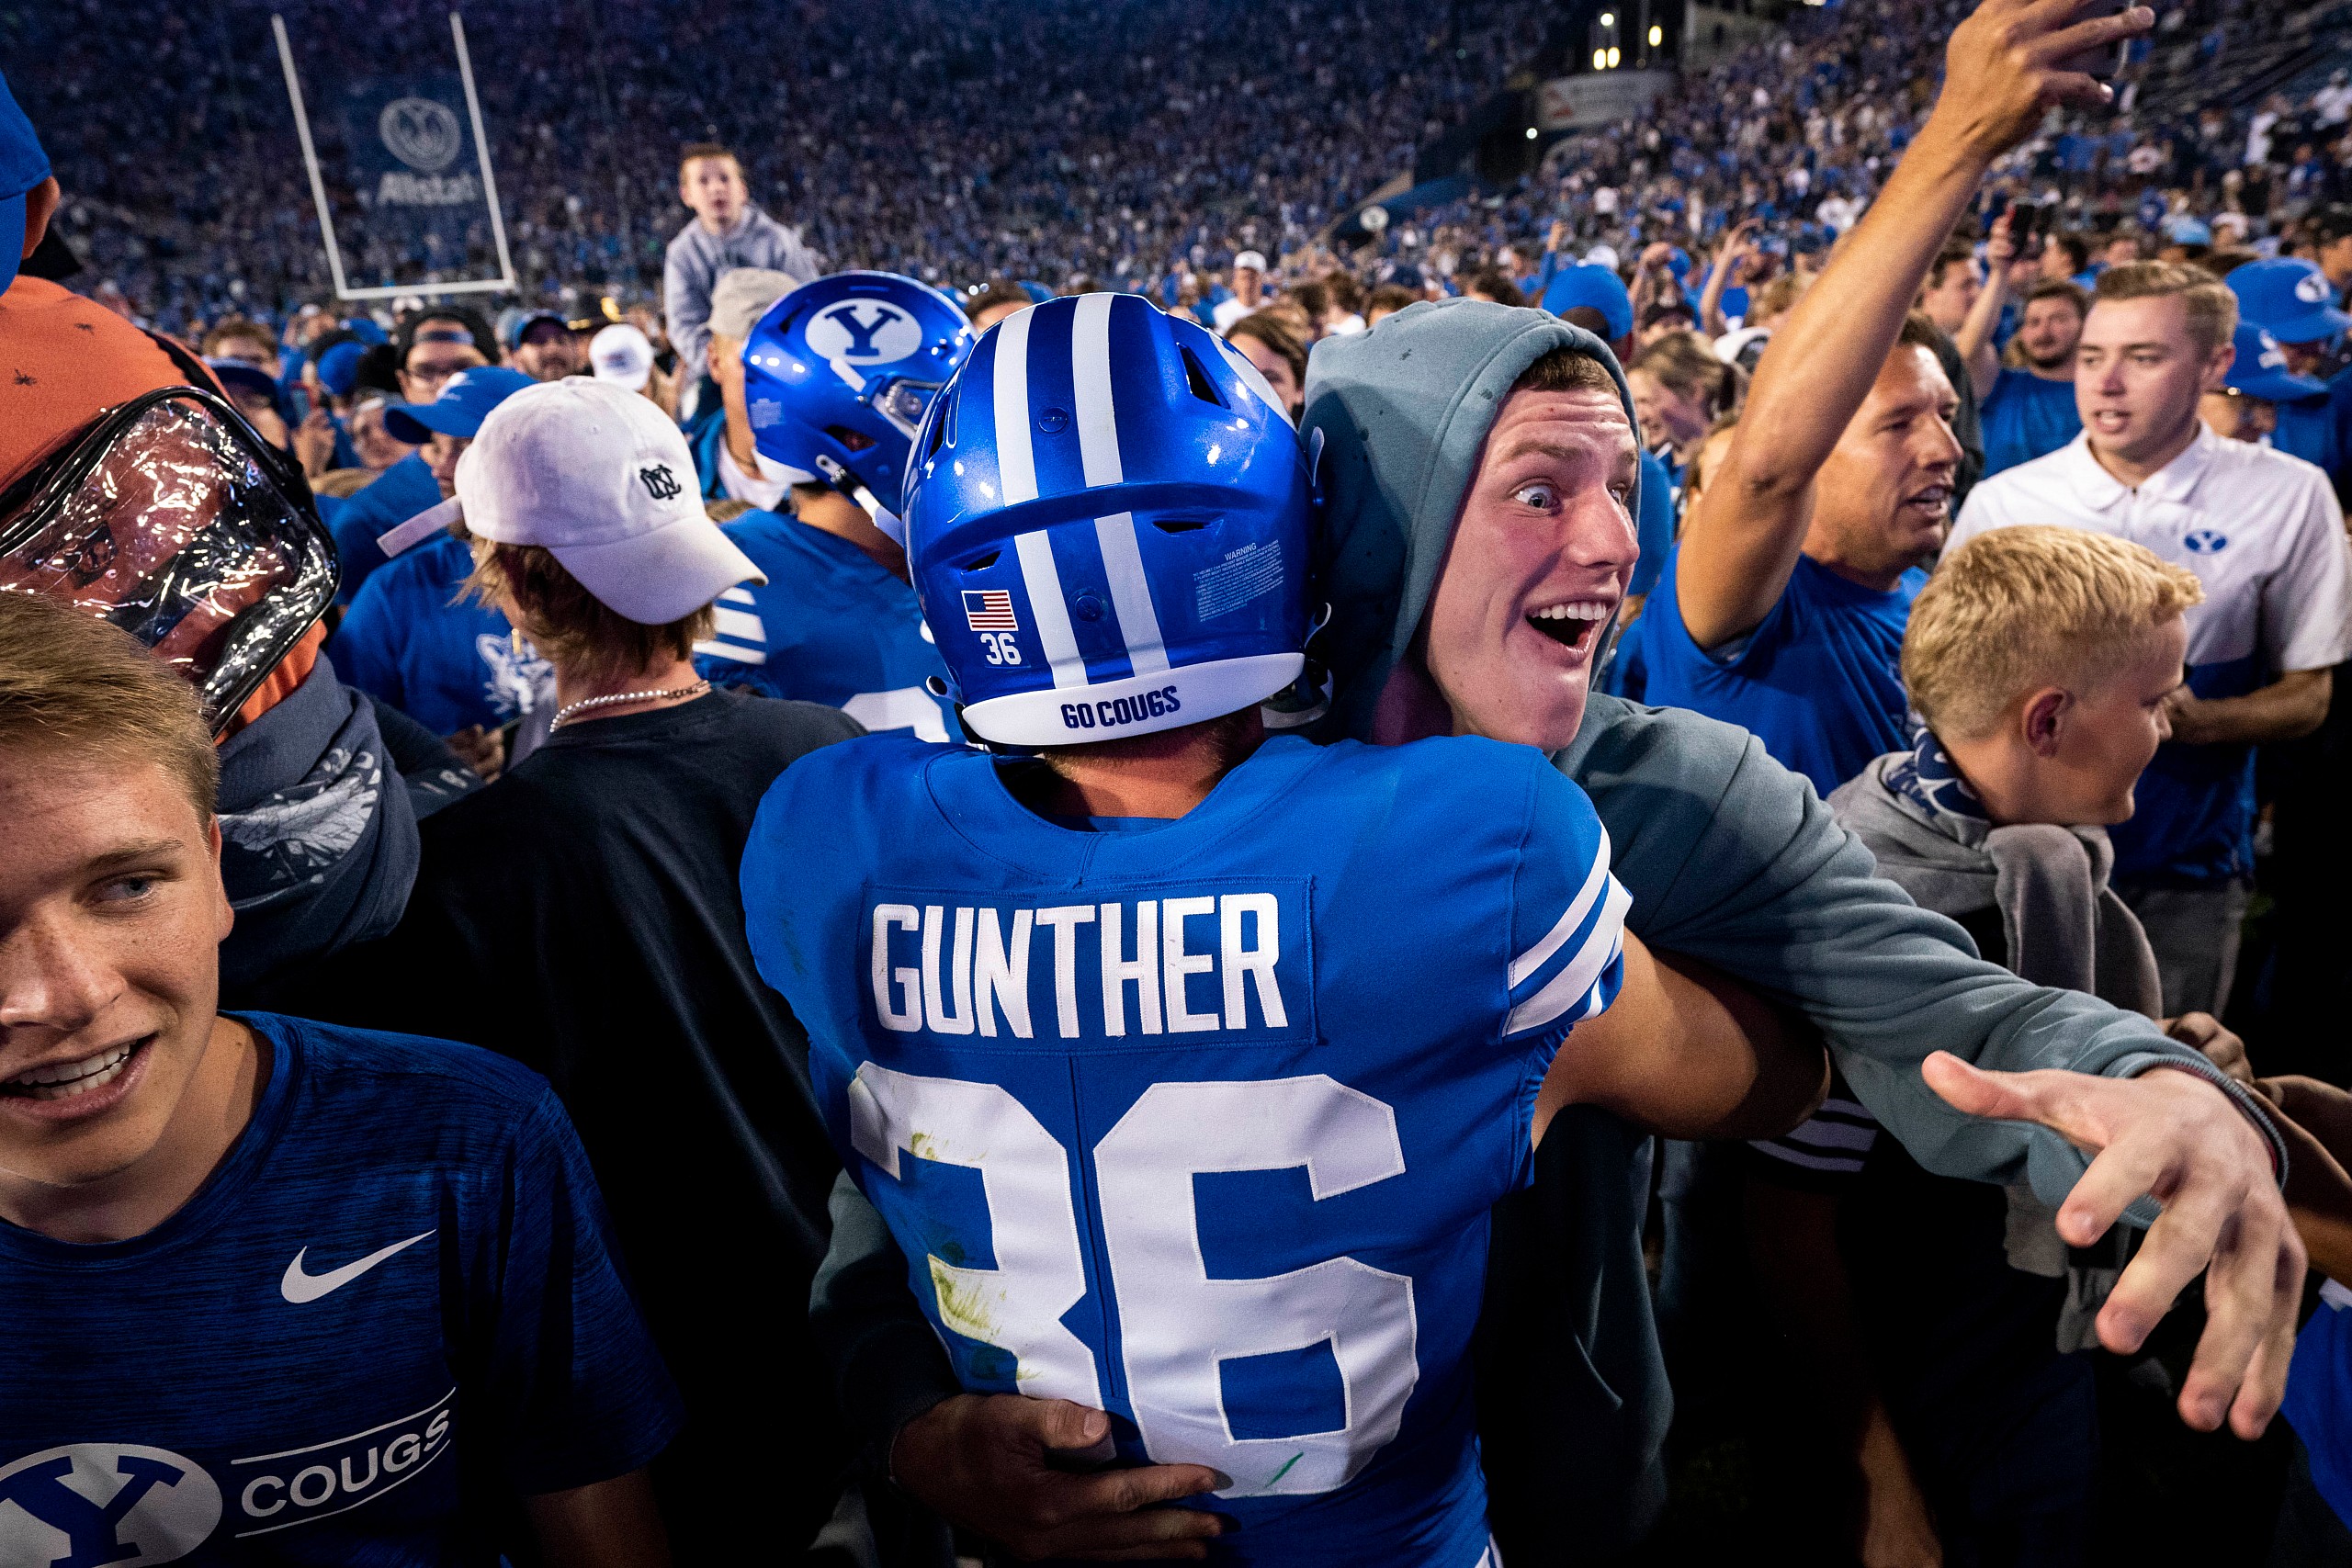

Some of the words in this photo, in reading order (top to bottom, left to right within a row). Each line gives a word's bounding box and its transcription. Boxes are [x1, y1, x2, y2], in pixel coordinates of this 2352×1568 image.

[825, 305, 902, 356] Y
[1225, 542, 1257, 560] WARNING
[980, 632, 1022, 665] 36
[1060, 703, 1096, 728] GO
[1096, 685, 1181, 727] COUGS
[872, 892, 1288, 1039] GUNTHER
[848, 1060, 1420, 1500] 36
[241, 1409, 450, 1517] COUGS
